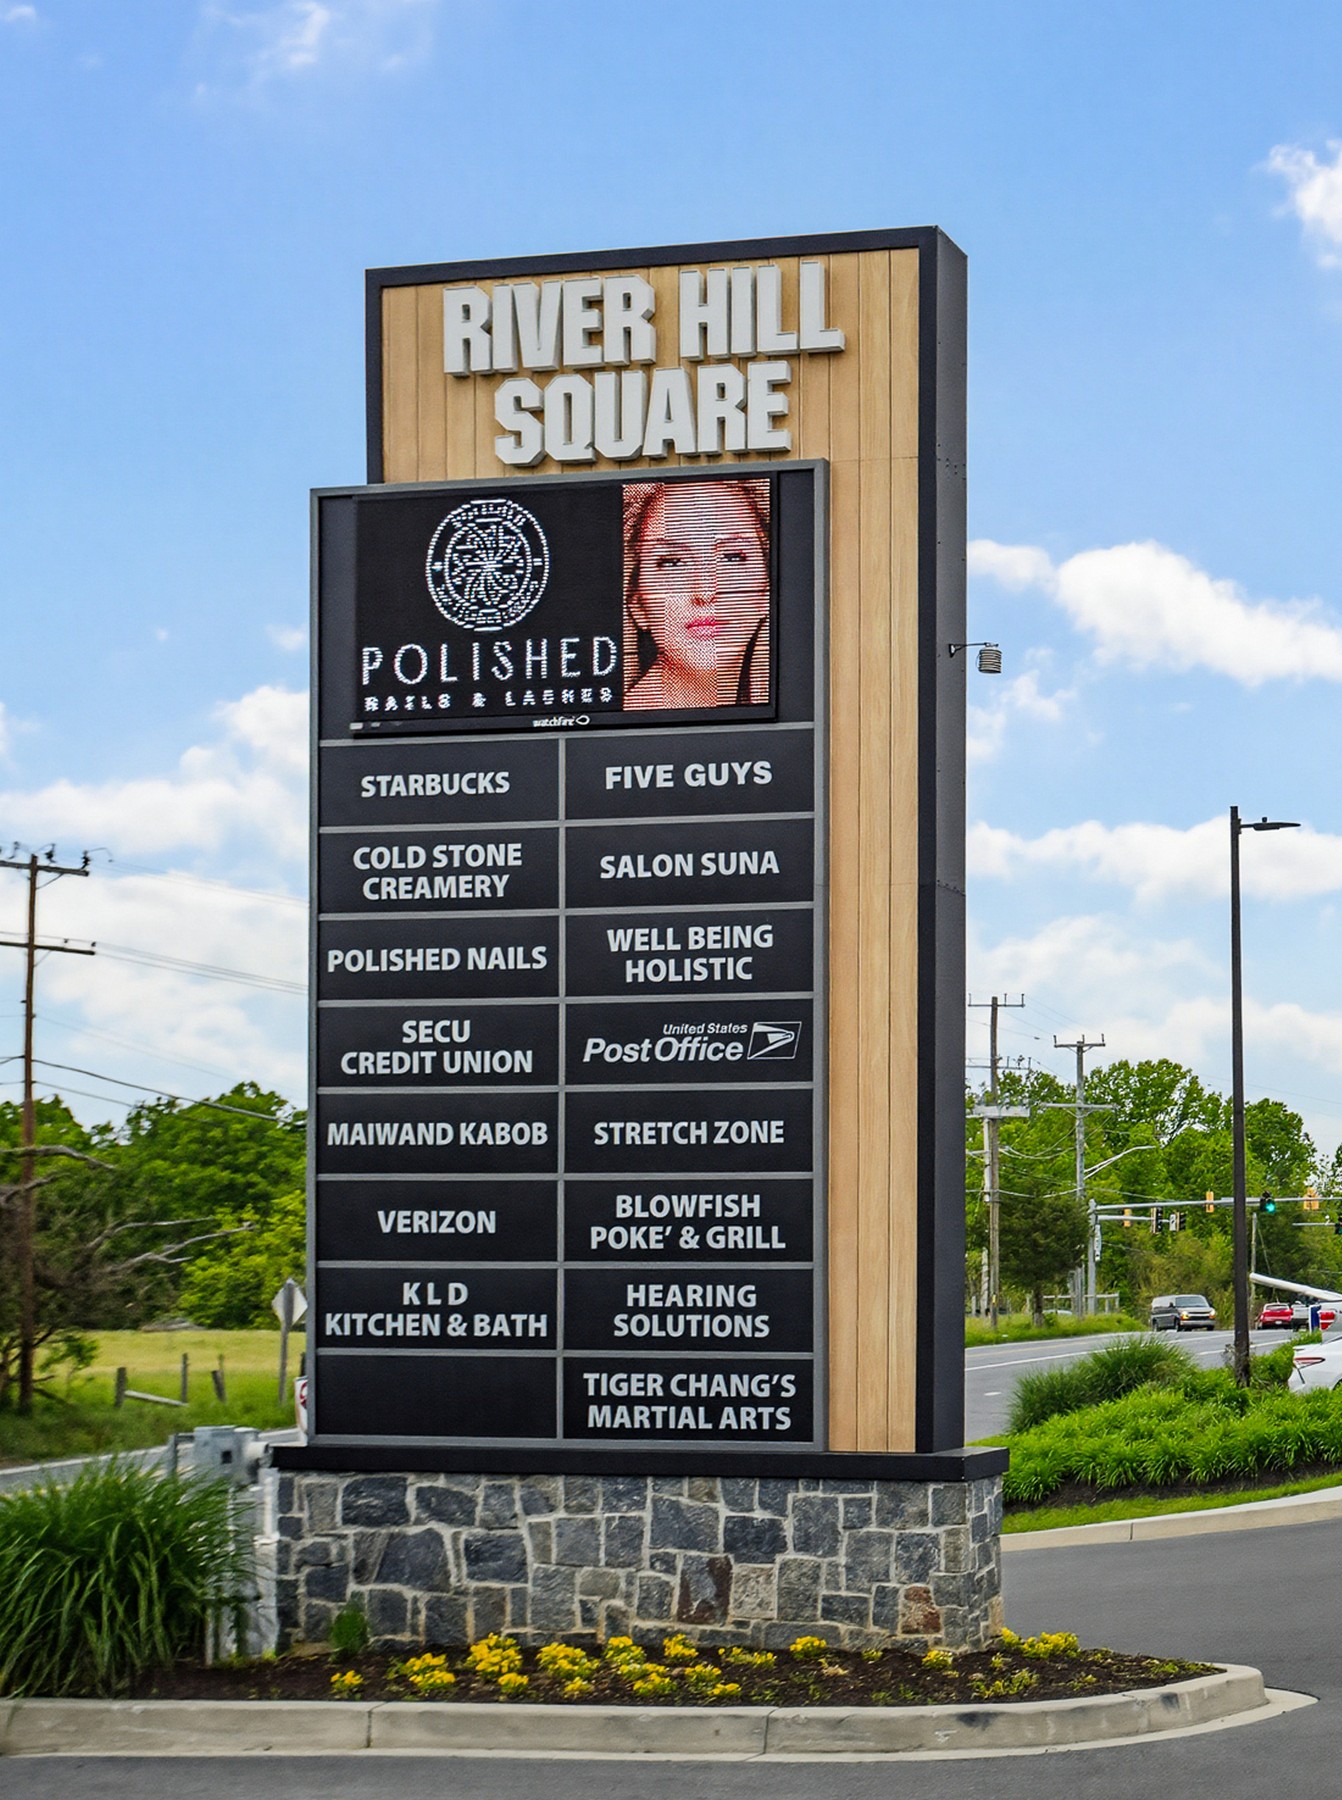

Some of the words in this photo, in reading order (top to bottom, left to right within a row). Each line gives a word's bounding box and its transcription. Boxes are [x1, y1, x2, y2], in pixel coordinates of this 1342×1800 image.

[442, 273, 657, 378] RIVER
[679, 259, 846, 362] HILL
[494, 360, 792, 467] SQUARE
[361, 636, 618, 686] POLISHED
[361, 772, 510, 797] STARBUCKS
[606, 765, 674, 789] FIVE
[684, 761, 772, 786] GUYS
[353, 846, 426, 869] COLD
[433, 843, 522, 867] STONE
[601, 854, 693, 878] SALON
[701, 851, 779, 875] SUNA
[363, 875, 509, 900] CREAMERY
[607, 928, 681, 952] WELL
[689, 925, 773, 949] BEING
[328, 948, 460, 972] POLISHED
[468, 946, 547, 970] NAILS
[626, 957, 752, 982] HOLISTIC
[403, 1020, 470, 1043] SECU
[663, 1023, 704, 1035] United
[707, 1023, 747, 1033] States
[582, 1037, 653, 1063] Post
[654, 1036, 744, 1062] Office
[341, 1051, 436, 1074] CREDIT
[444, 1050, 532, 1073] UNION
[328, 1123, 453, 1145] MAIWAND
[460, 1122, 547, 1145] KABOB
[595, 1122, 707, 1144] STRETCH
[713, 1121, 784, 1143] ZONE
[617, 1195, 760, 1217] BLOWFISH
[378, 1211, 495, 1233] VERIZON
[680, 1226, 699, 1249] &
[707, 1226, 785, 1248] GRILL
[627, 1285, 756, 1307] HEARING
[326, 1313, 440, 1336] KITCHEN
[447, 1314, 467, 1336] &
[474, 1314, 546, 1336] BATH
[614, 1314, 769, 1337] SOLUTIONS
[584, 1373, 663, 1396] TIGER
[589, 1405, 712, 1428] MARTIAL
[719, 1407, 790, 1429] ARTS
